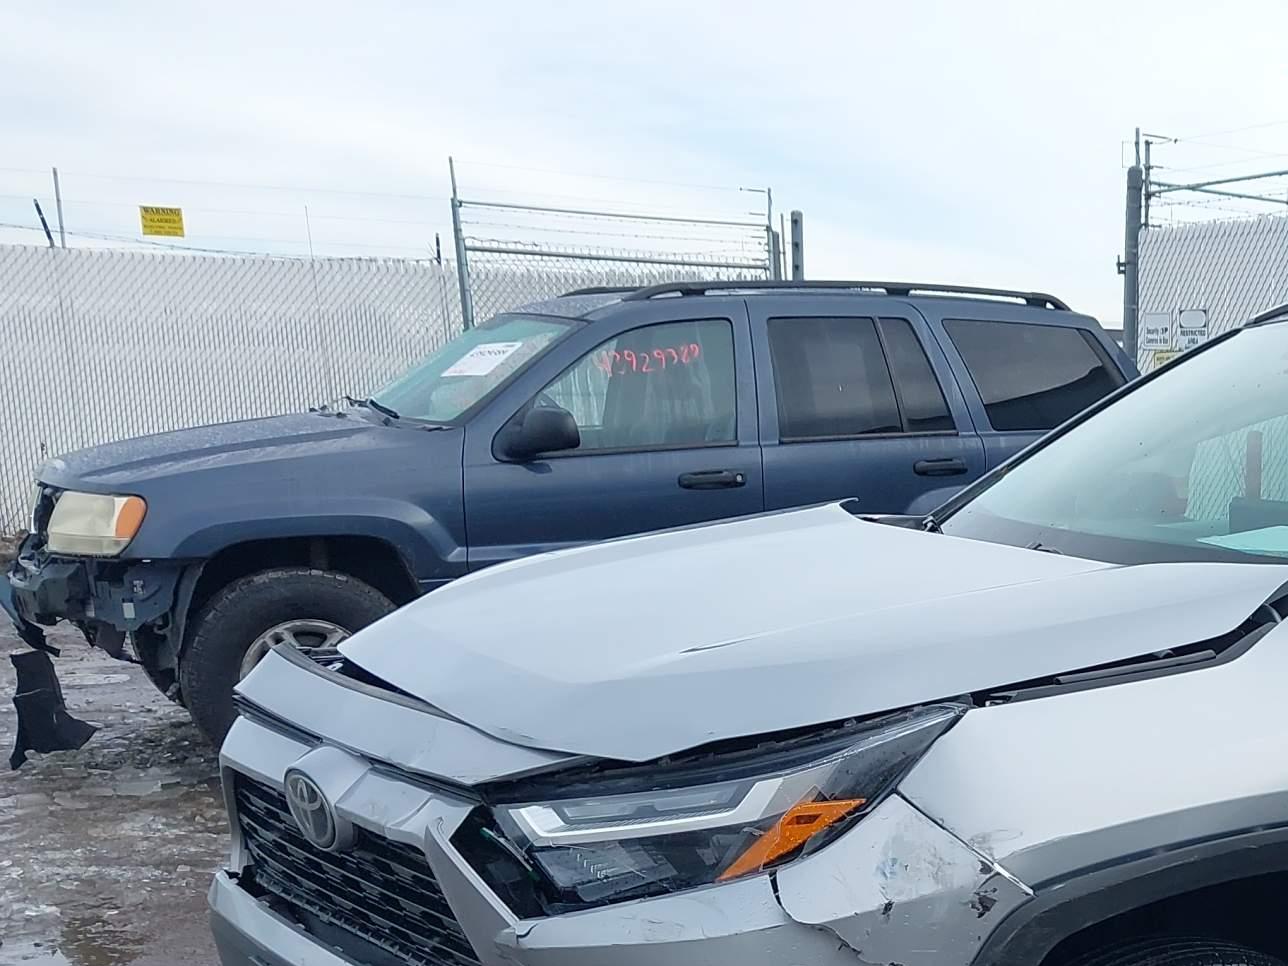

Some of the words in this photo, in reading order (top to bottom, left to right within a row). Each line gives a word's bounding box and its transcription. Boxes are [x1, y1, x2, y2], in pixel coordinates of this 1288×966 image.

[143, 207, 181, 216] WARNING
[1180, 329, 1206, 337] RESTRICTED
[1187, 337, 1199, 345] AREA
